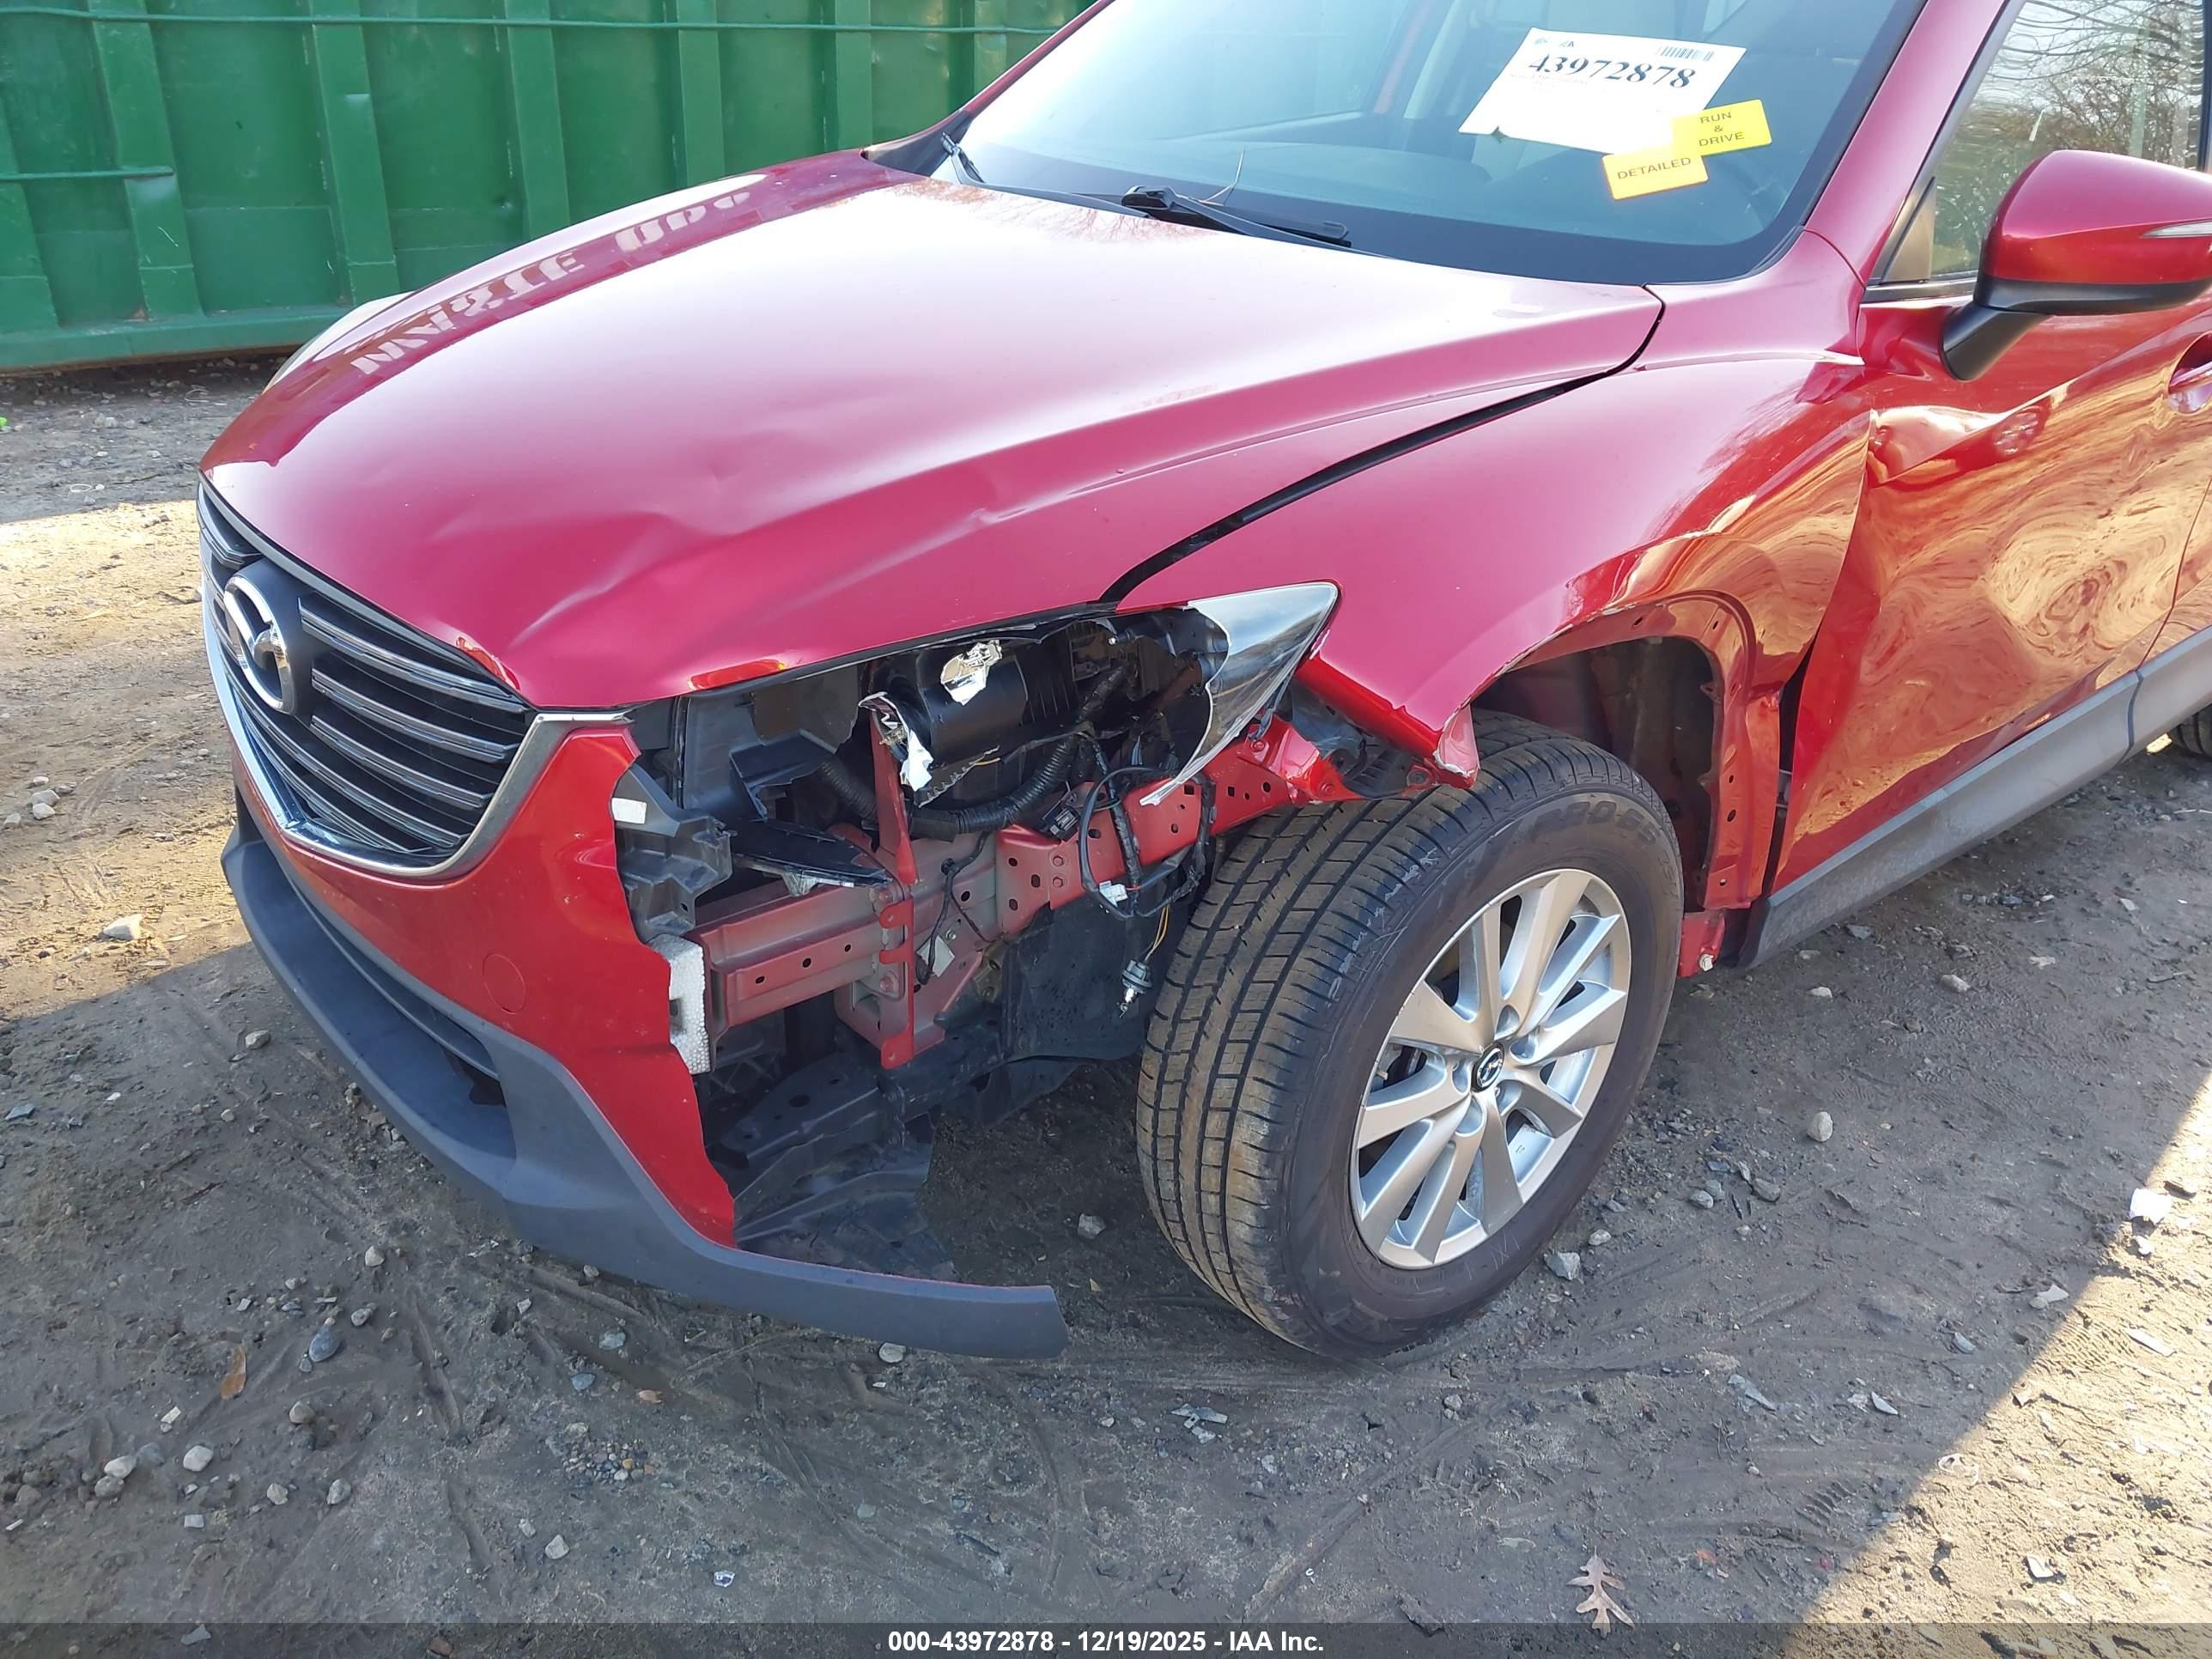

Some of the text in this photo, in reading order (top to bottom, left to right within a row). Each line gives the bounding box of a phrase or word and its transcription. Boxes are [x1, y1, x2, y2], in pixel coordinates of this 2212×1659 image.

[1528, 53, 1696, 88] 43972878
[1699, 112, 1732, 124] RUN
[1698, 131, 1744, 147] DRIVE
[1617, 157, 1692, 179] DETAILED
